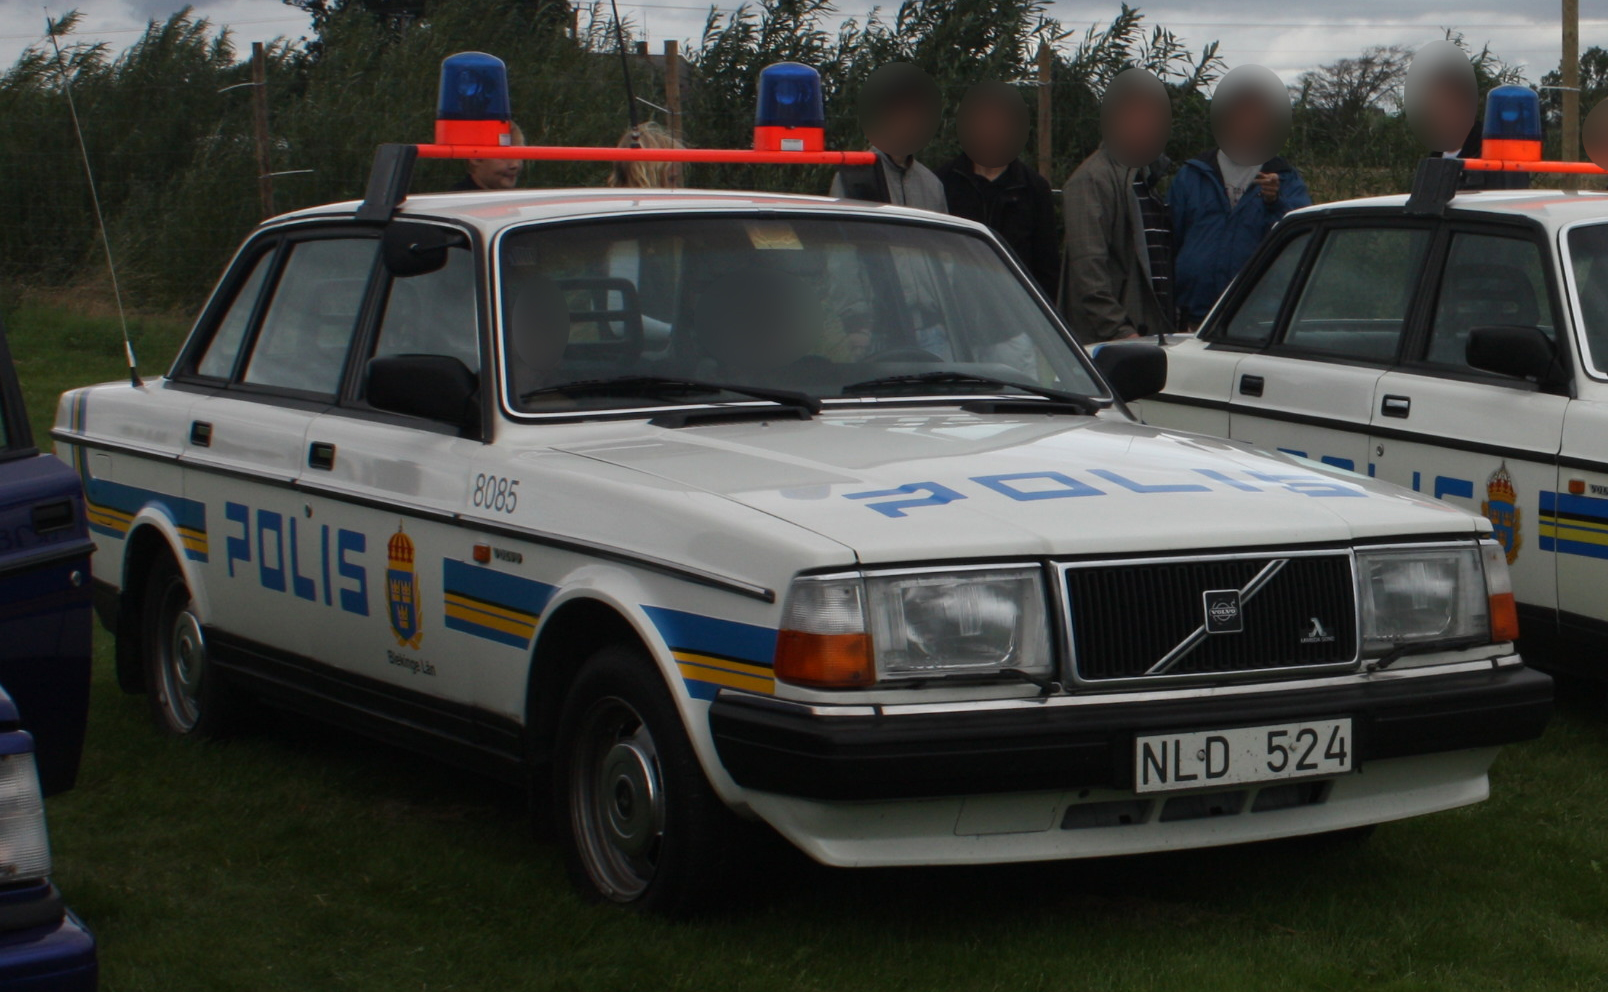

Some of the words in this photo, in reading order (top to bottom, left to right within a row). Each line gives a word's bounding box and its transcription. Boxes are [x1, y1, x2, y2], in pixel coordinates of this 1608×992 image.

[473, 472, 520, 514] 8085
[841, 468, 1370, 519] POLIS
[224, 501, 370, 617] POLIS
[1210, 608, 1237, 616] VOLVO
[1142, 735, 1231, 786] NLD
[1266, 725, 1348, 773] 524
